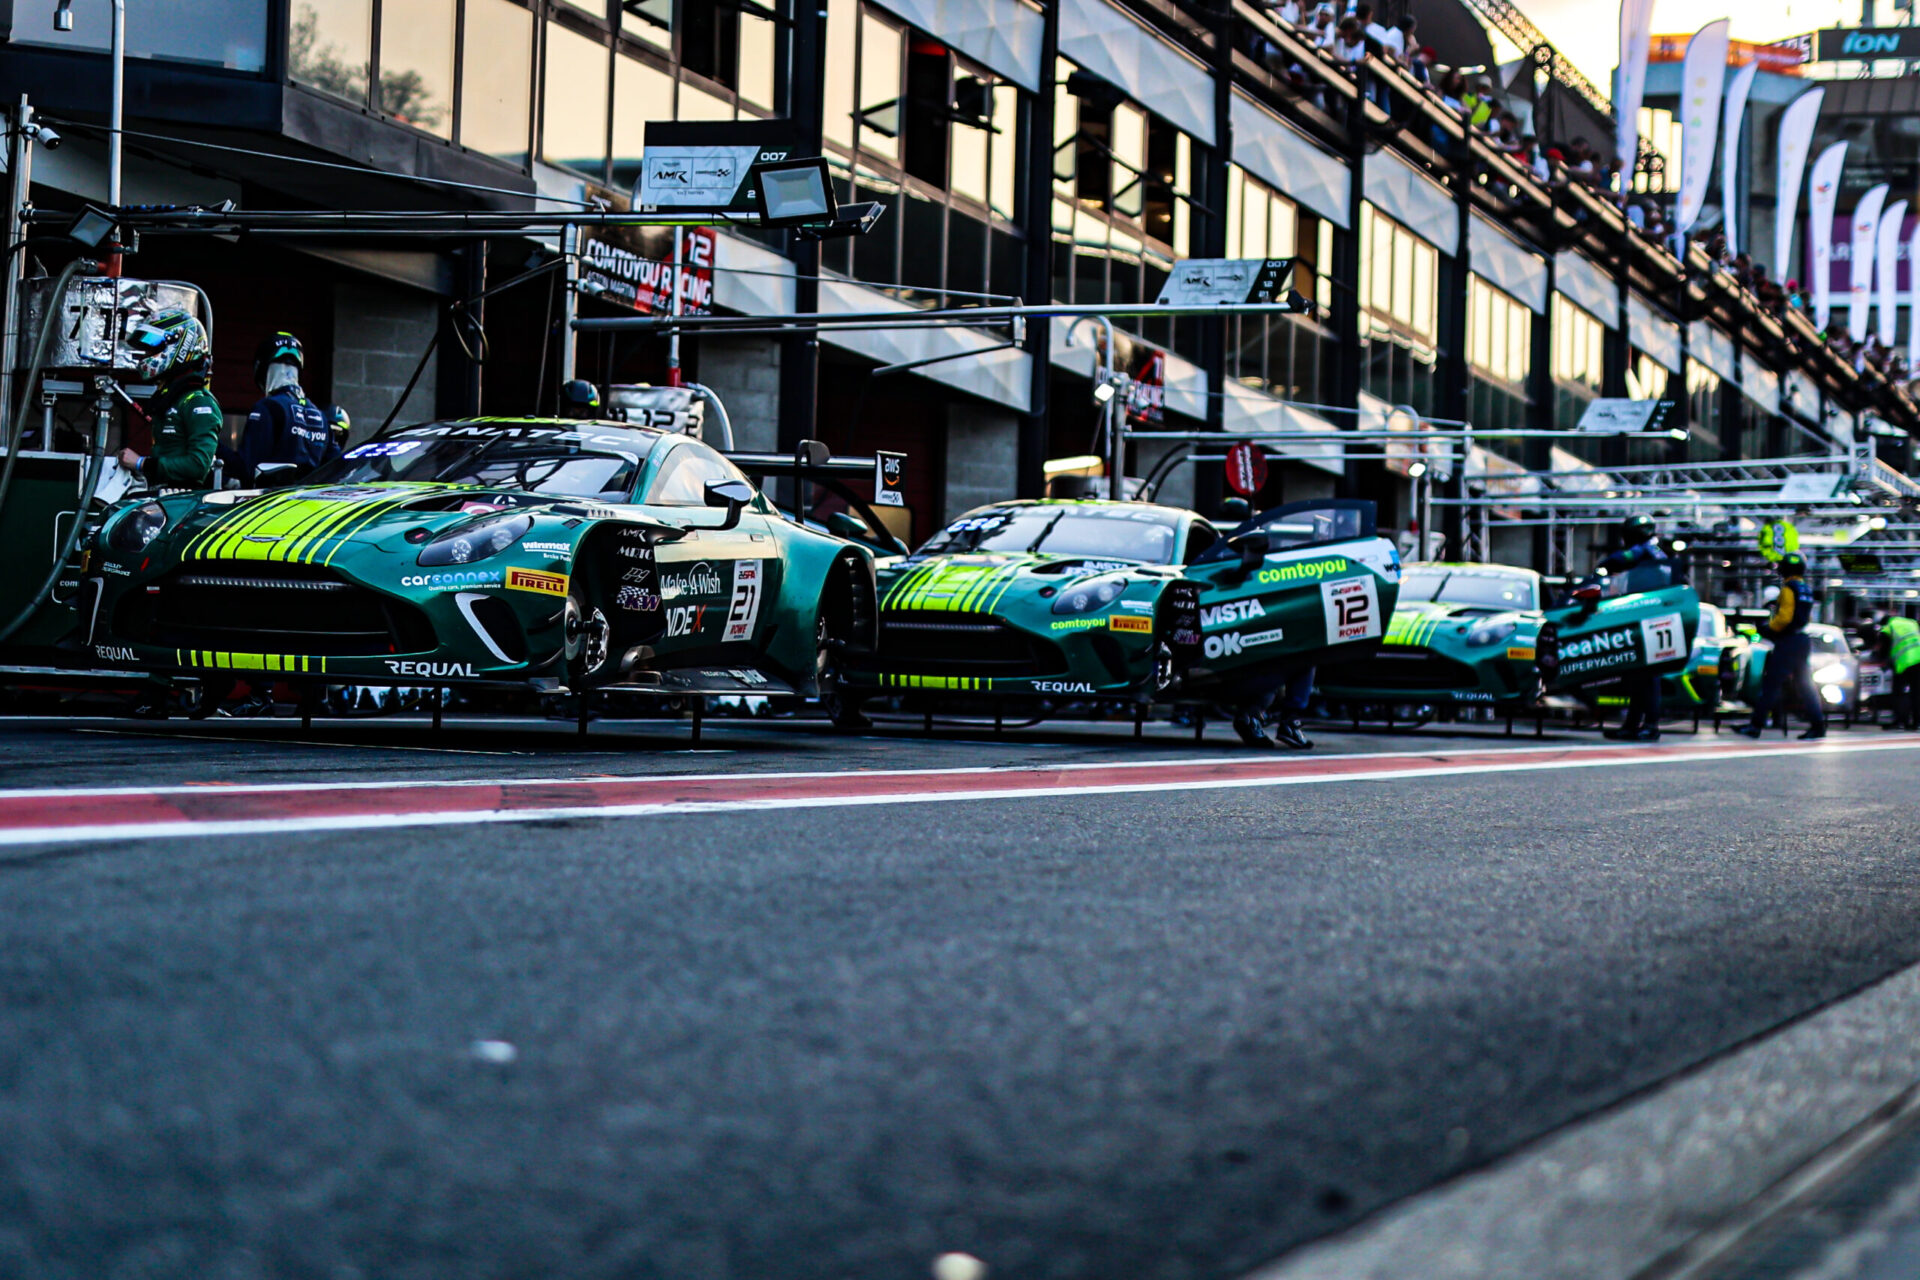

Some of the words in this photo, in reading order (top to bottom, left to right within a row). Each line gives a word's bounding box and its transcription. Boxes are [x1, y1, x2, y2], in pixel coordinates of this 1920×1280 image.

[761, 152, 787, 161] 007
[653, 171, 688, 184] AMR
[688, 232, 712, 268] 12
[586, 238, 660, 288] COMTOYOU
[660, 265, 712, 306] RCING
[389, 426, 630, 446] FANATEC
[885, 458, 900, 474] aws
[617, 528, 646, 542] AMR
[401, 571, 500, 587] carconnex
[1258, 558, 1348, 584] comtoyou
[511, 571, 565, 593] PIRELLI
[730, 585, 756, 621] 21
[1335, 594, 1370, 627] 12
[1051, 618, 1106, 631] comtoyou
[1338, 626, 1367, 638] ROWE
[1204, 631, 1242, 659] OK
[1656, 629, 1673, 649] 11
[95, 644, 140, 661] REQUAL
[384, 660, 480, 678] REQUAL
[1030, 680, 1097, 694] REQUAL
